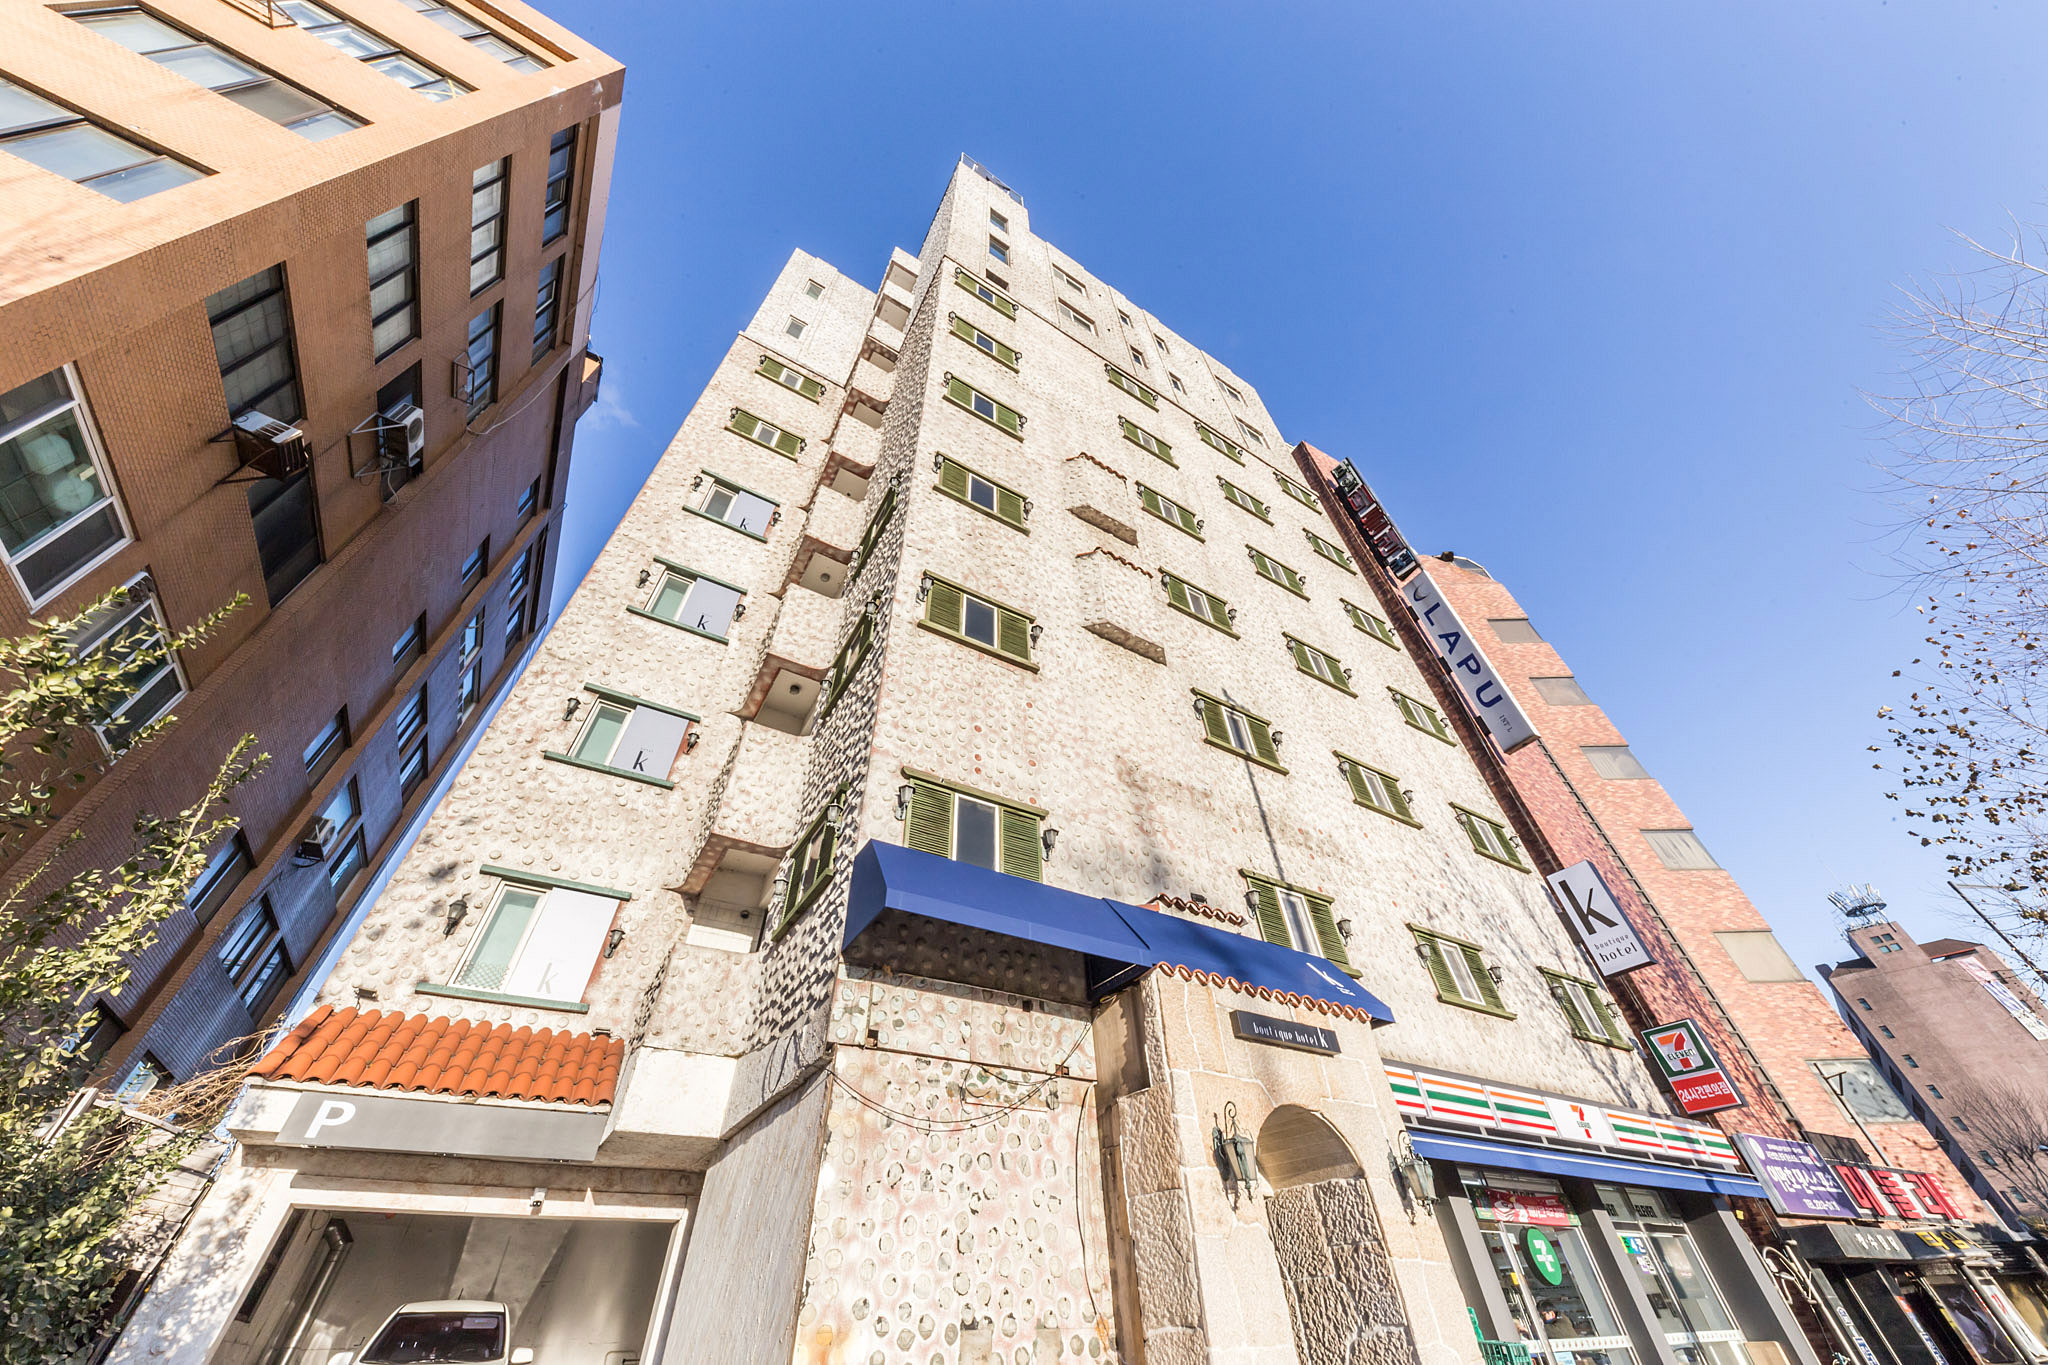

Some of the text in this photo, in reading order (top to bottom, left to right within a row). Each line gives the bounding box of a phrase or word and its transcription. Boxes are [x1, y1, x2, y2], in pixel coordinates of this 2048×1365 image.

[1424, 602, 1503, 708] LAPU
[1594, 934, 1629, 950] boutique
[1599, 942, 1637, 963] hotel
[1253, 1022, 1292, 1042] boutique
[1295, 1031, 1318, 1046] hotel
[1678, 1081, 1730, 1102] 24시간편의점
[304, 1100, 356, 1139] P
